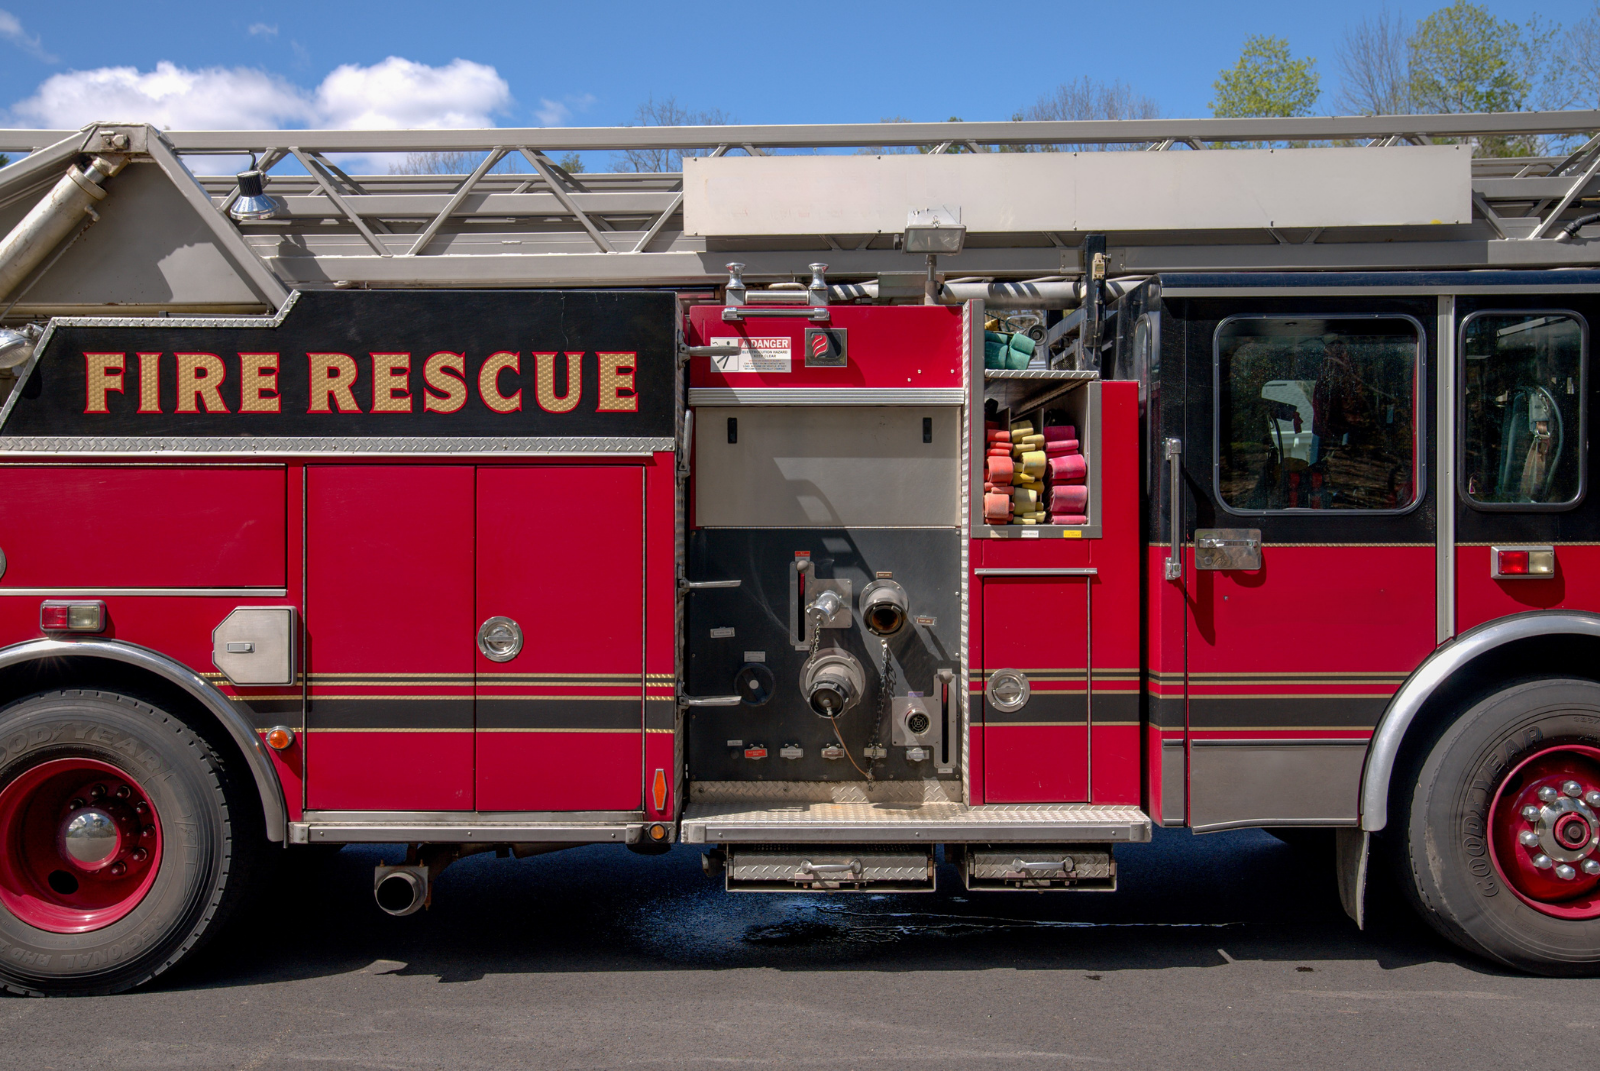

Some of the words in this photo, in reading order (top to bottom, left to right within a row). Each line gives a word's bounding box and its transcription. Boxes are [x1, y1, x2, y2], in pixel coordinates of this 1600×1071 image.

[751, 339, 789, 348] DANGER
[82, 351, 283, 415] FIRE
[305, 350, 640, 415] RESCUE
[1463, 725, 1544, 898] GOODYEAR
[59, 912, 167, 970] REGIONAL
